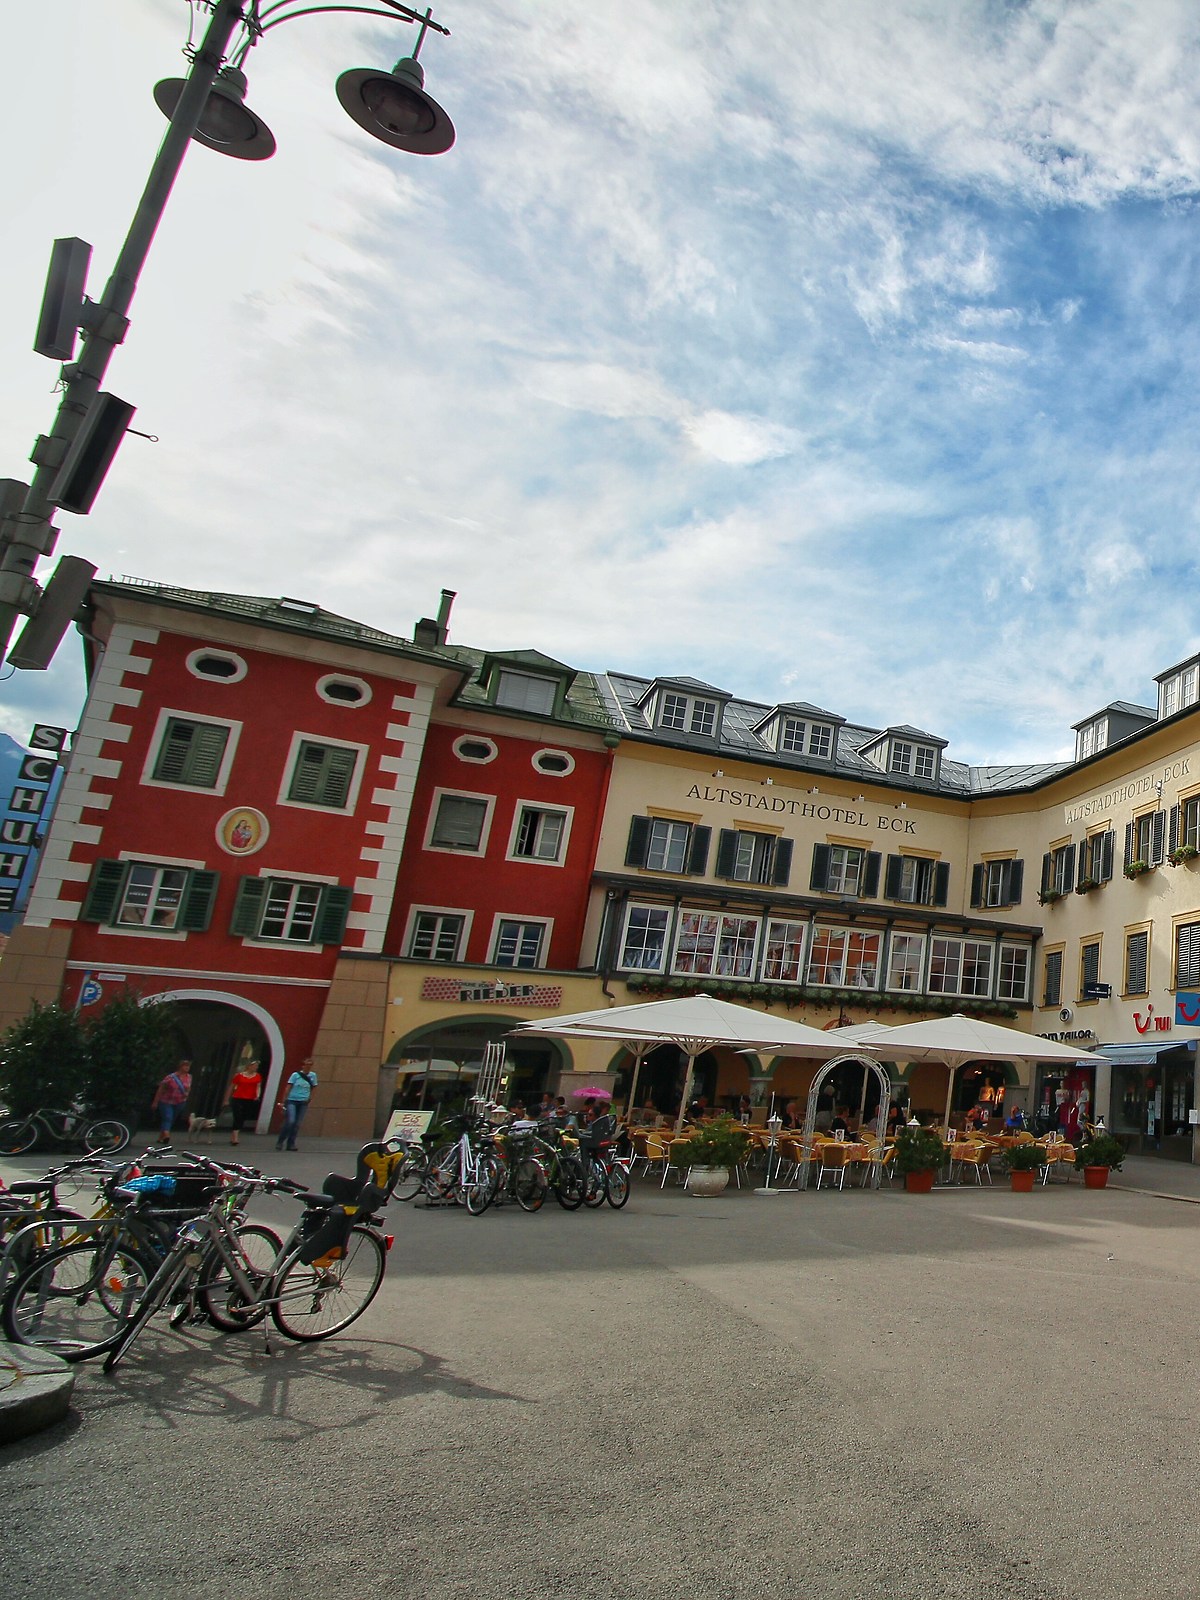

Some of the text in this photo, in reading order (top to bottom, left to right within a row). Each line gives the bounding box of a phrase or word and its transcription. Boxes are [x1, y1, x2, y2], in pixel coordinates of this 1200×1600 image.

[1066, 758, 1191, 825] ALTSTADTHOTEL ECK
[686, 784, 918, 835] ALTSTADTHOTEL ECK
[460, 984, 535, 1002] RIEDER
[1060, 1030, 1092, 1041] TAILOR
[402, 1113, 421, 1124] Eis
